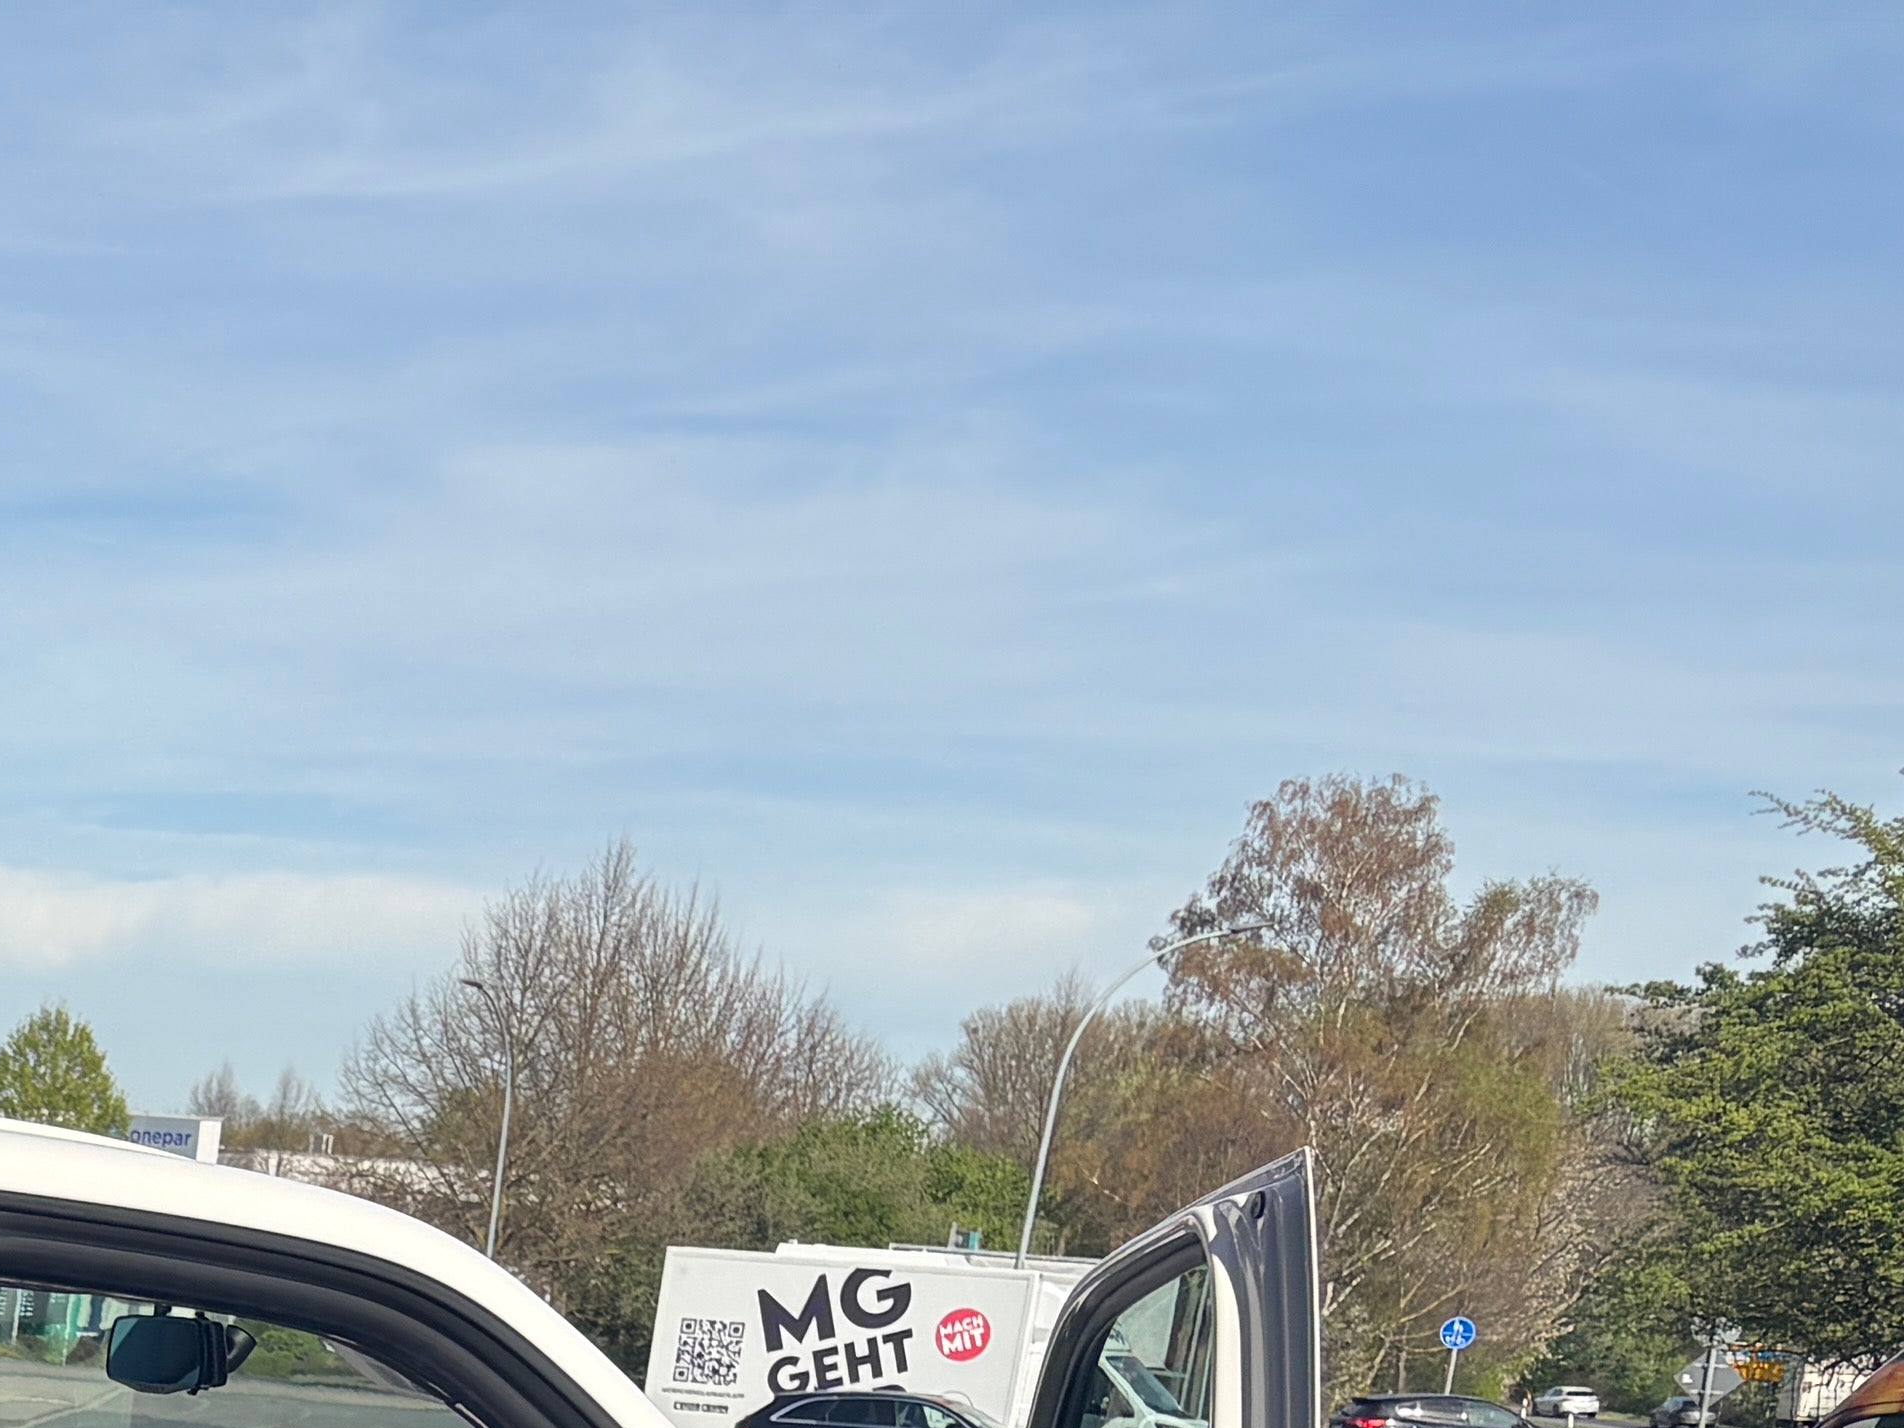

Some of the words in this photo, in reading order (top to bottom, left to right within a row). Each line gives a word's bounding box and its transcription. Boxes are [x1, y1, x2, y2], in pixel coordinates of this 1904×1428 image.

[129, 1129, 192, 1147] onepar
[757, 1267, 912, 1353] MG
[939, 1314, 984, 1336] MACH
[942, 1327, 985, 1355] MIT
[767, 1328, 913, 1393] GEHT
